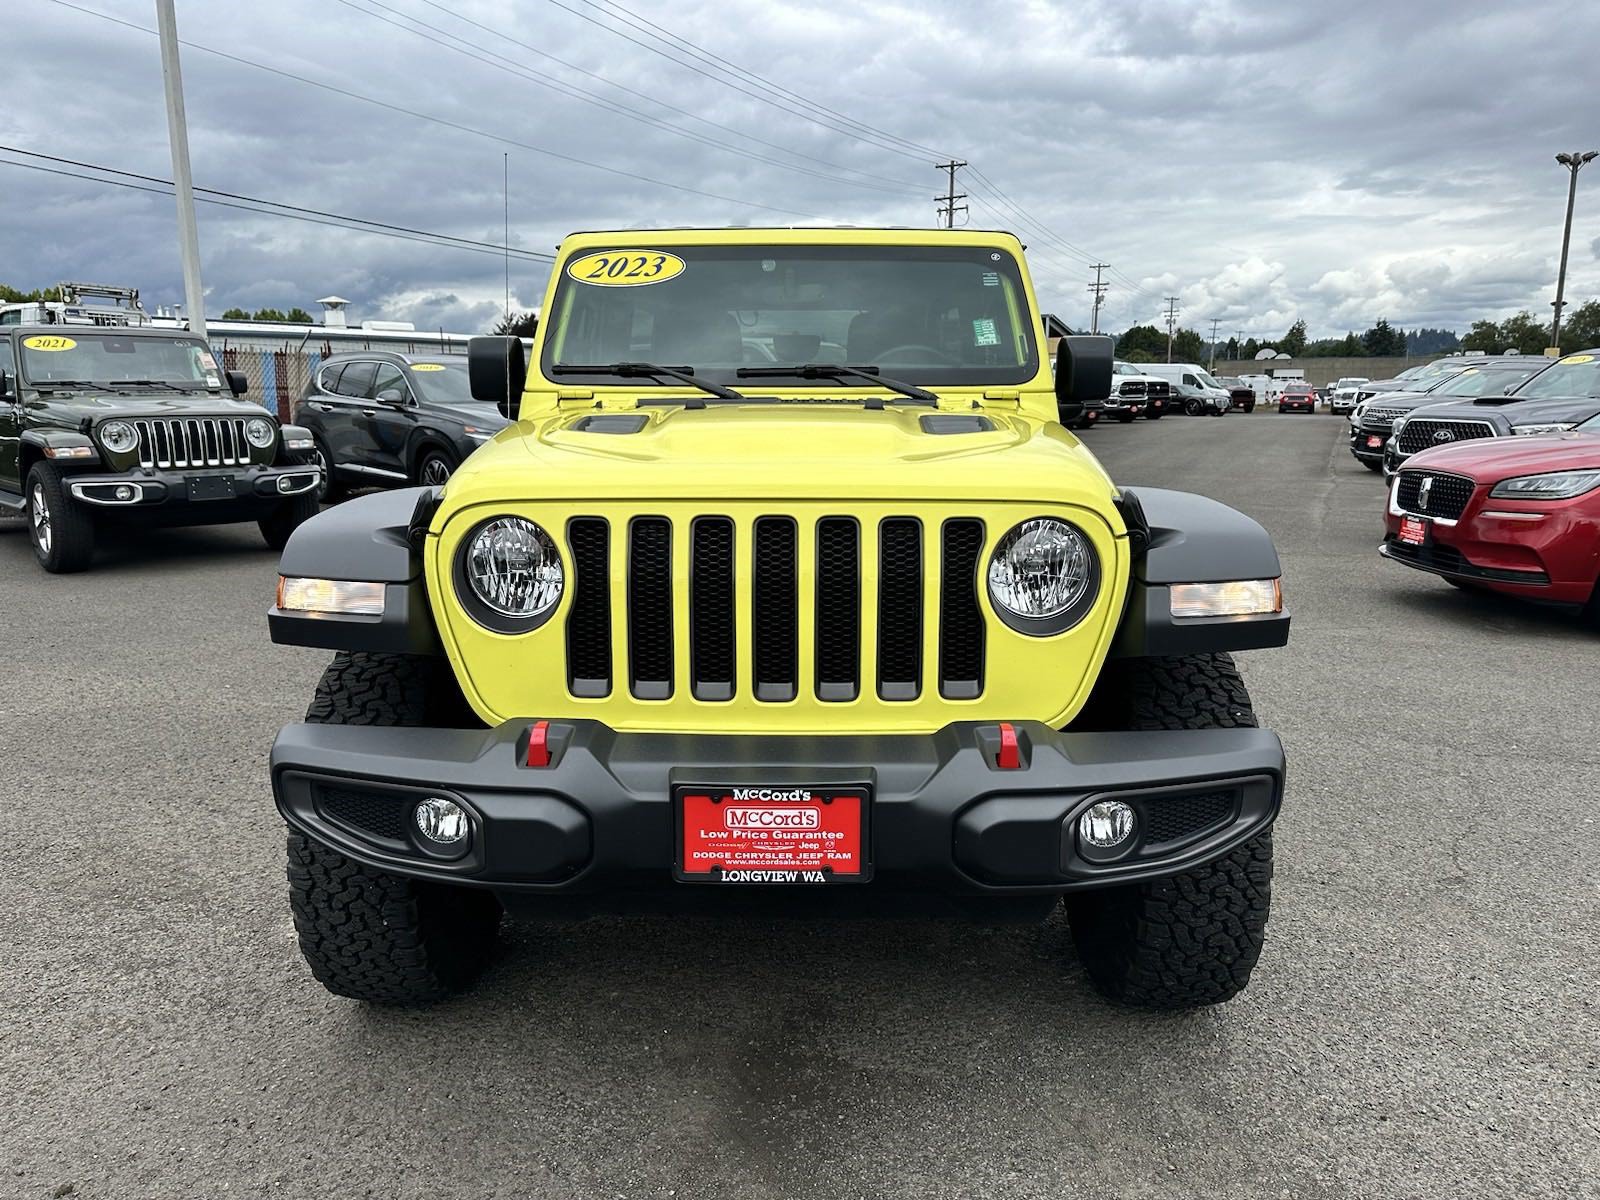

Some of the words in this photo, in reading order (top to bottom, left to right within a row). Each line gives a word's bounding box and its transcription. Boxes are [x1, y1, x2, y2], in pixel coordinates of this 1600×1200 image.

[586, 256, 667, 278] 2023
[34, 339, 67, 348] 2021
[733, 789, 811, 802] McCord's
[730, 811, 815, 826] McCord's
[700, 830, 729, 840] Low
[733, 830, 768, 840] Price
[772, 830, 844, 840] Guarantee
[798, 841, 820, 850] Jeep
[693, 851, 732, 859] DODGE
[827, 852, 852, 860] RAM
[721, 870, 798, 882] LONGVIEW
[802, 871, 826, 882] WA
